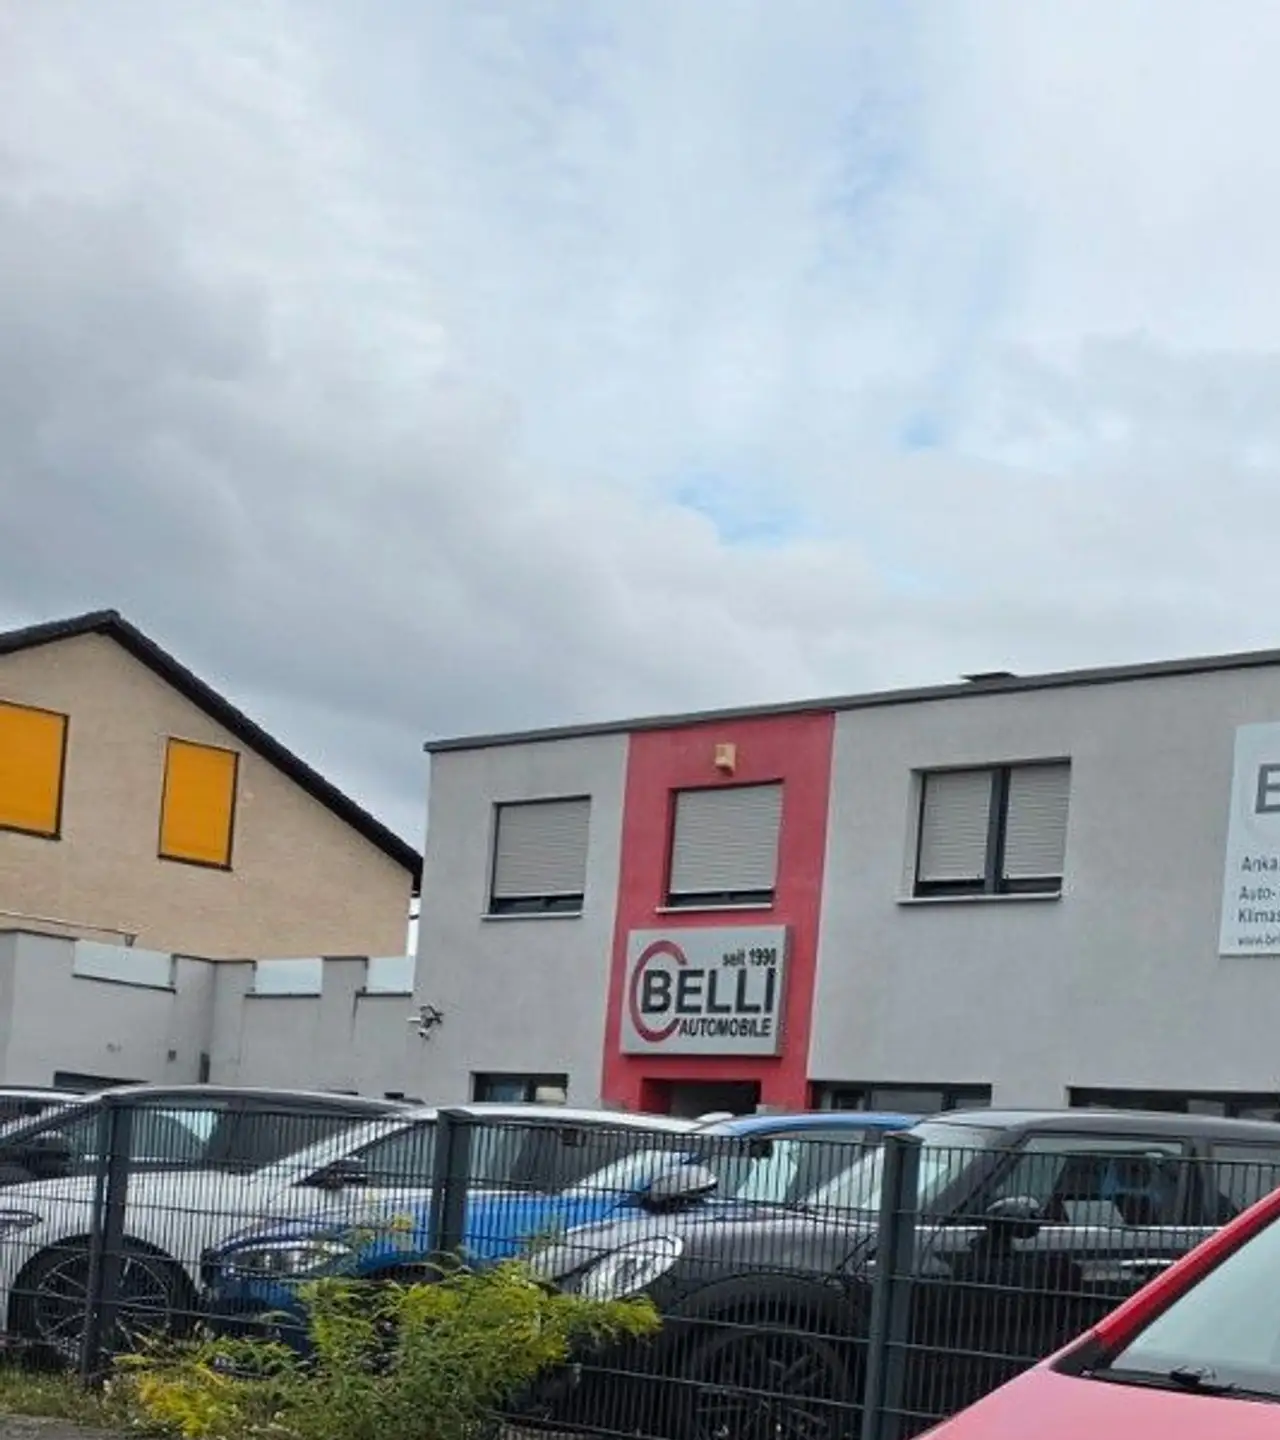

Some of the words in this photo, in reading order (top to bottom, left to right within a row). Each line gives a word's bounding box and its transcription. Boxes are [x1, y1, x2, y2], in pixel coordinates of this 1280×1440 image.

[722, 950, 746, 967] seit
[641, 968, 776, 1014] BELLI
[678, 1018, 773, 1038] AUTOMOBILE
